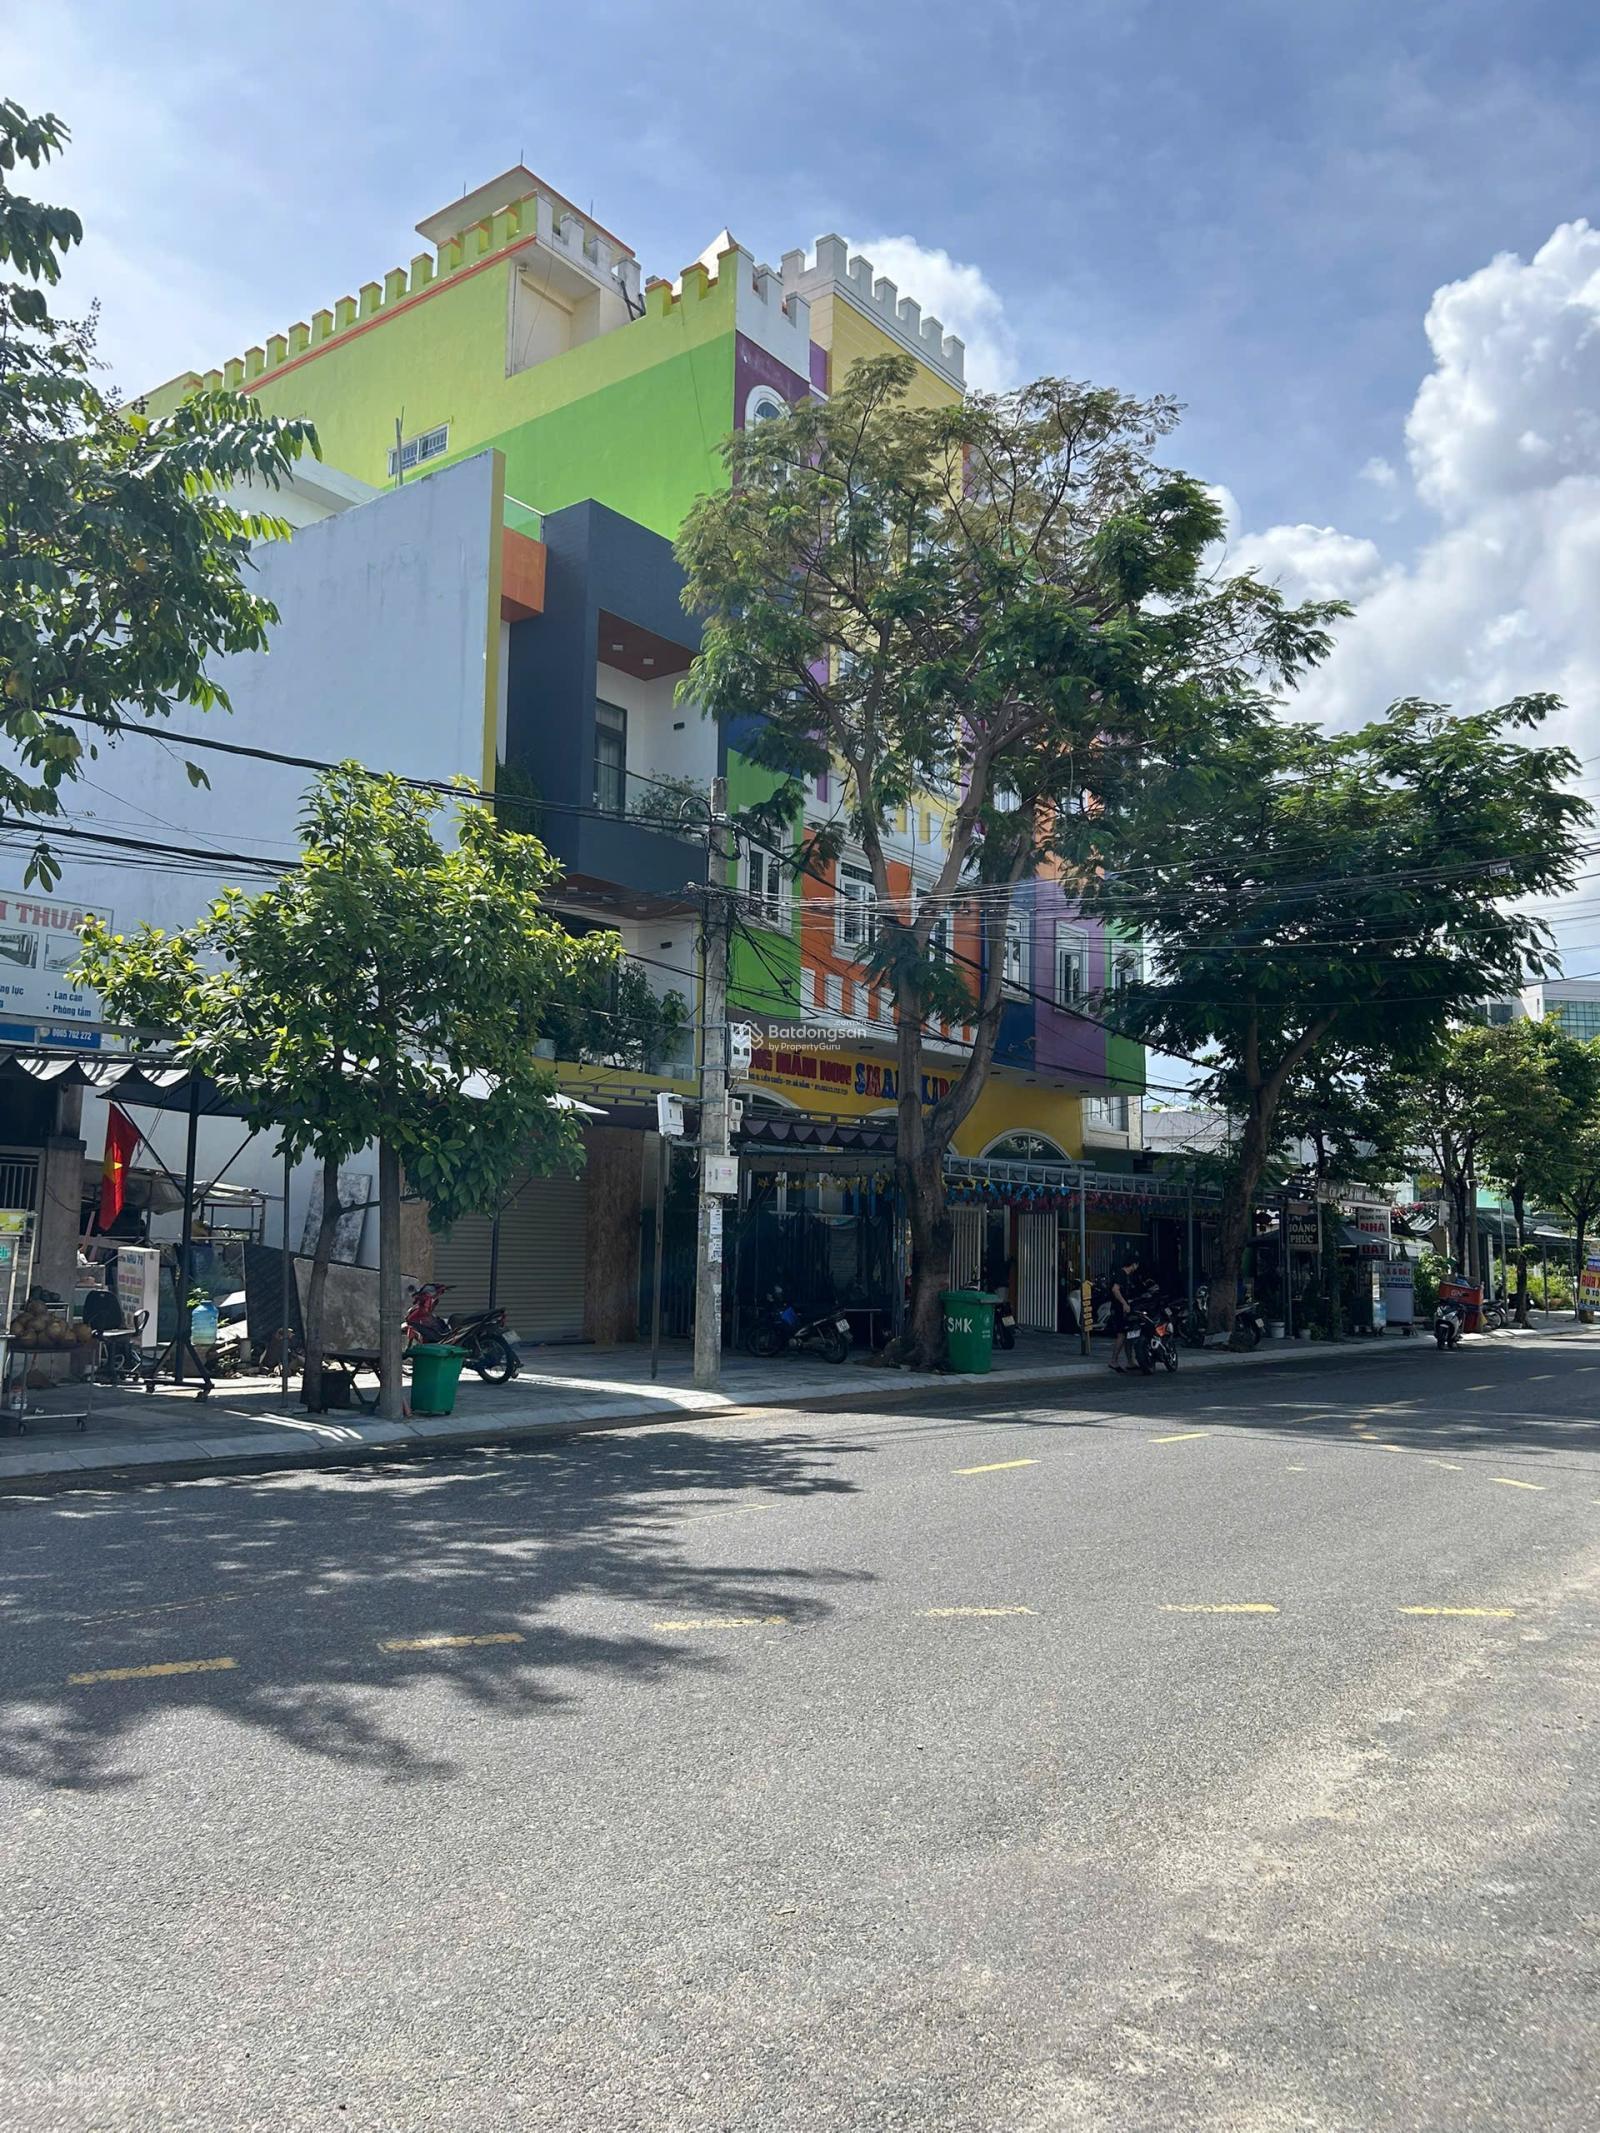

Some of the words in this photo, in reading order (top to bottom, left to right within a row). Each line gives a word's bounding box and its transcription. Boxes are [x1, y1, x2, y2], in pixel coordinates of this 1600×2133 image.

[16, 902, 105, 932] THUÂ
[54, 990, 68, 1001] Lan
[69, 993, 82, 1002] can
[947, 1316, 973, 1333] SMK
